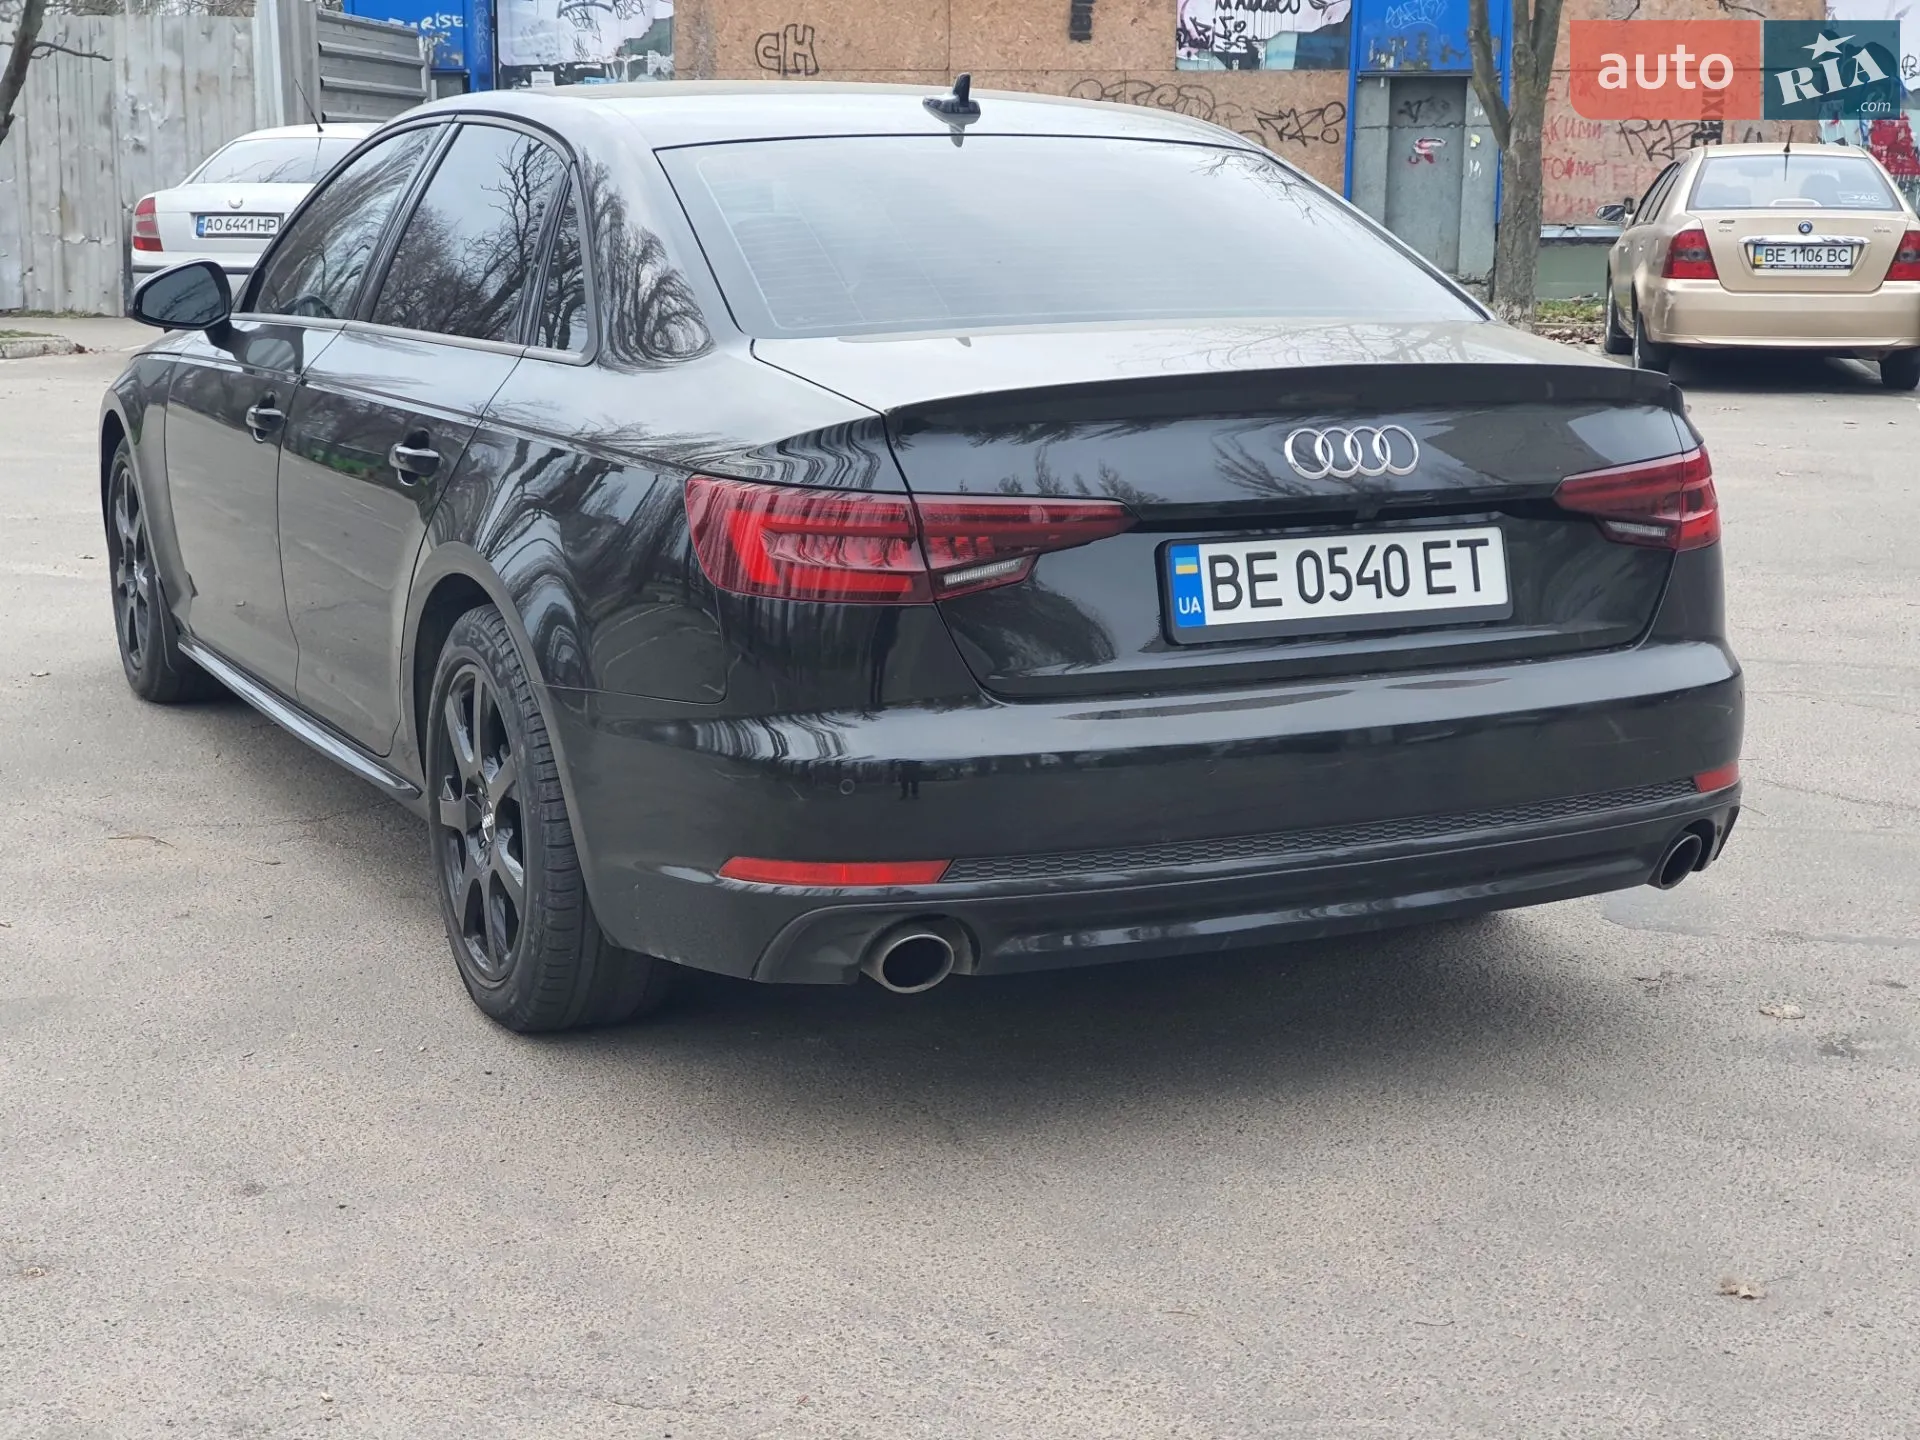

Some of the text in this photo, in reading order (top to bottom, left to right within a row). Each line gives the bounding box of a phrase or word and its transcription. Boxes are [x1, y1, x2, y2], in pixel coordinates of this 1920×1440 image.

[205, 216, 277, 232] AO 6441 HP
[1765, 248, 1849, 263] BE 1106 BC
[1208, 538, 1490, 612] BE 0540 ET
[1179, 596, 1202, 615] UA
